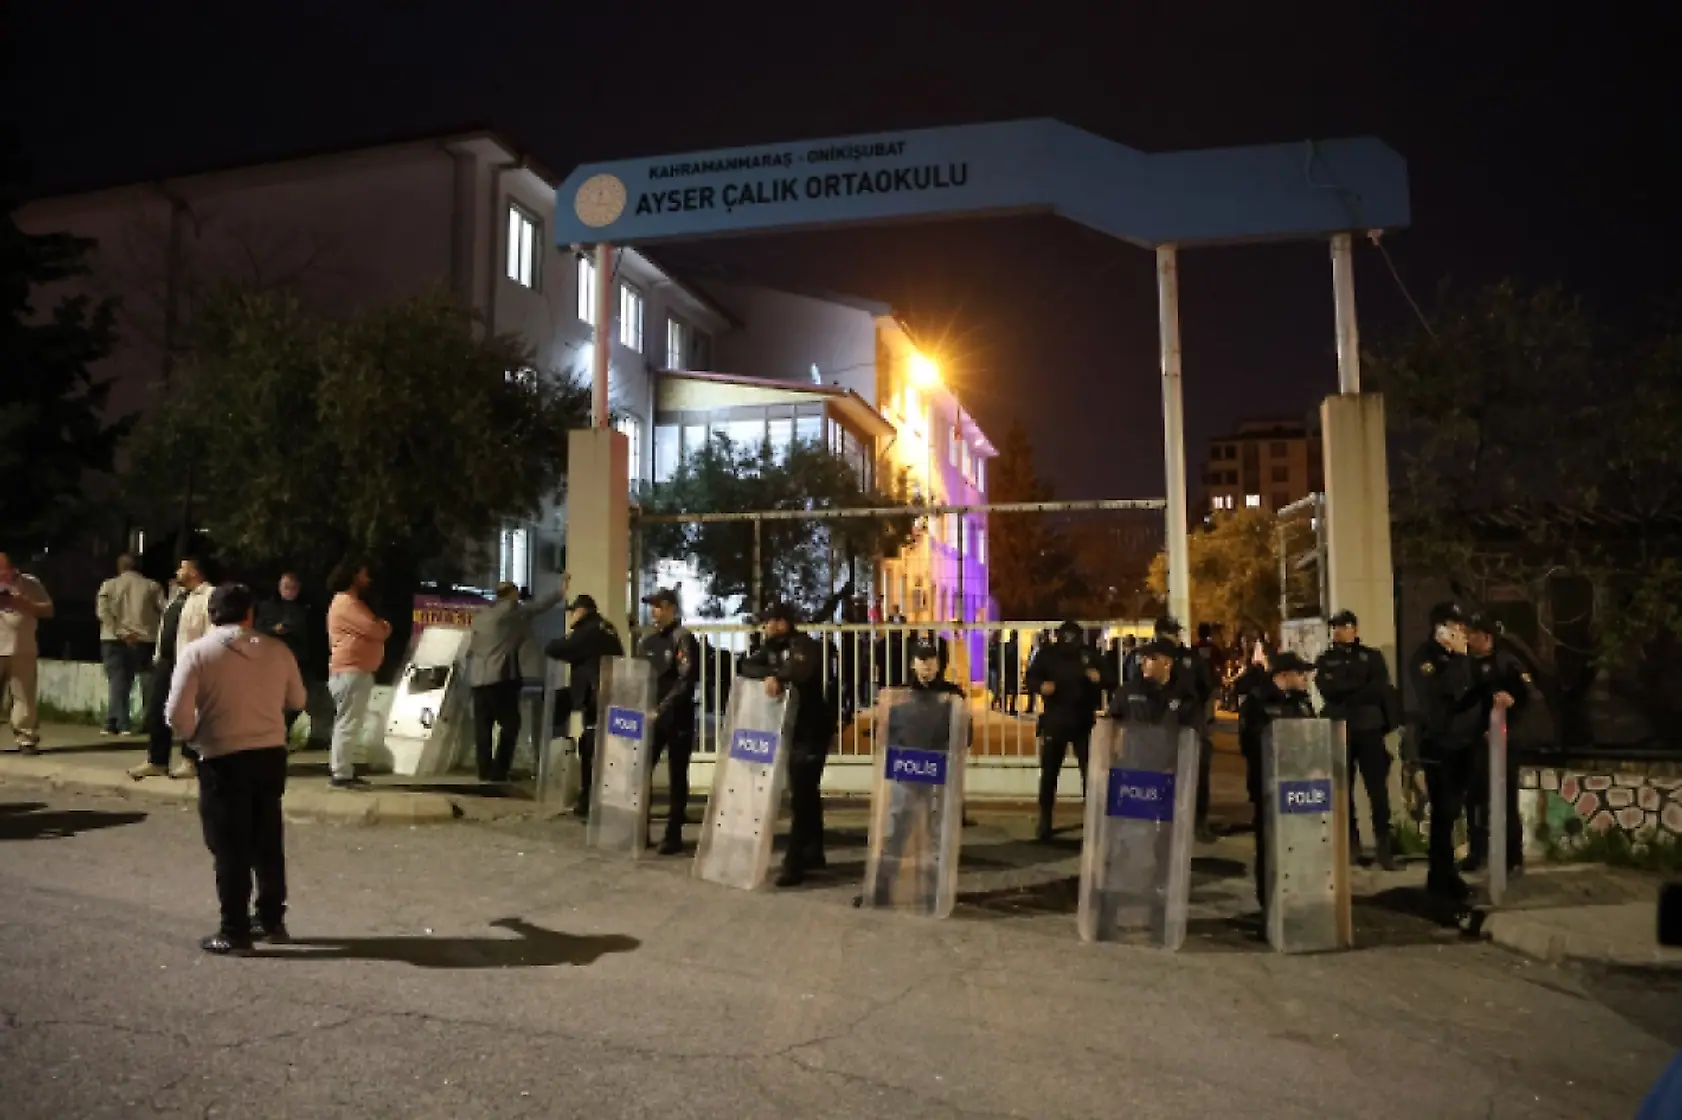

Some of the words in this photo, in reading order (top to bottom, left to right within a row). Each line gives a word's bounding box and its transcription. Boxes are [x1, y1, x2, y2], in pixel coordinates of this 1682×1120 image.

[649, 152, 793, 180] KAHRAMANMARAŞ
[635, 186, 716, 216] AYSER
[722, 177, 799, 213] ÇALIK
[805, 163, 968, 199] ORTAOKULU
